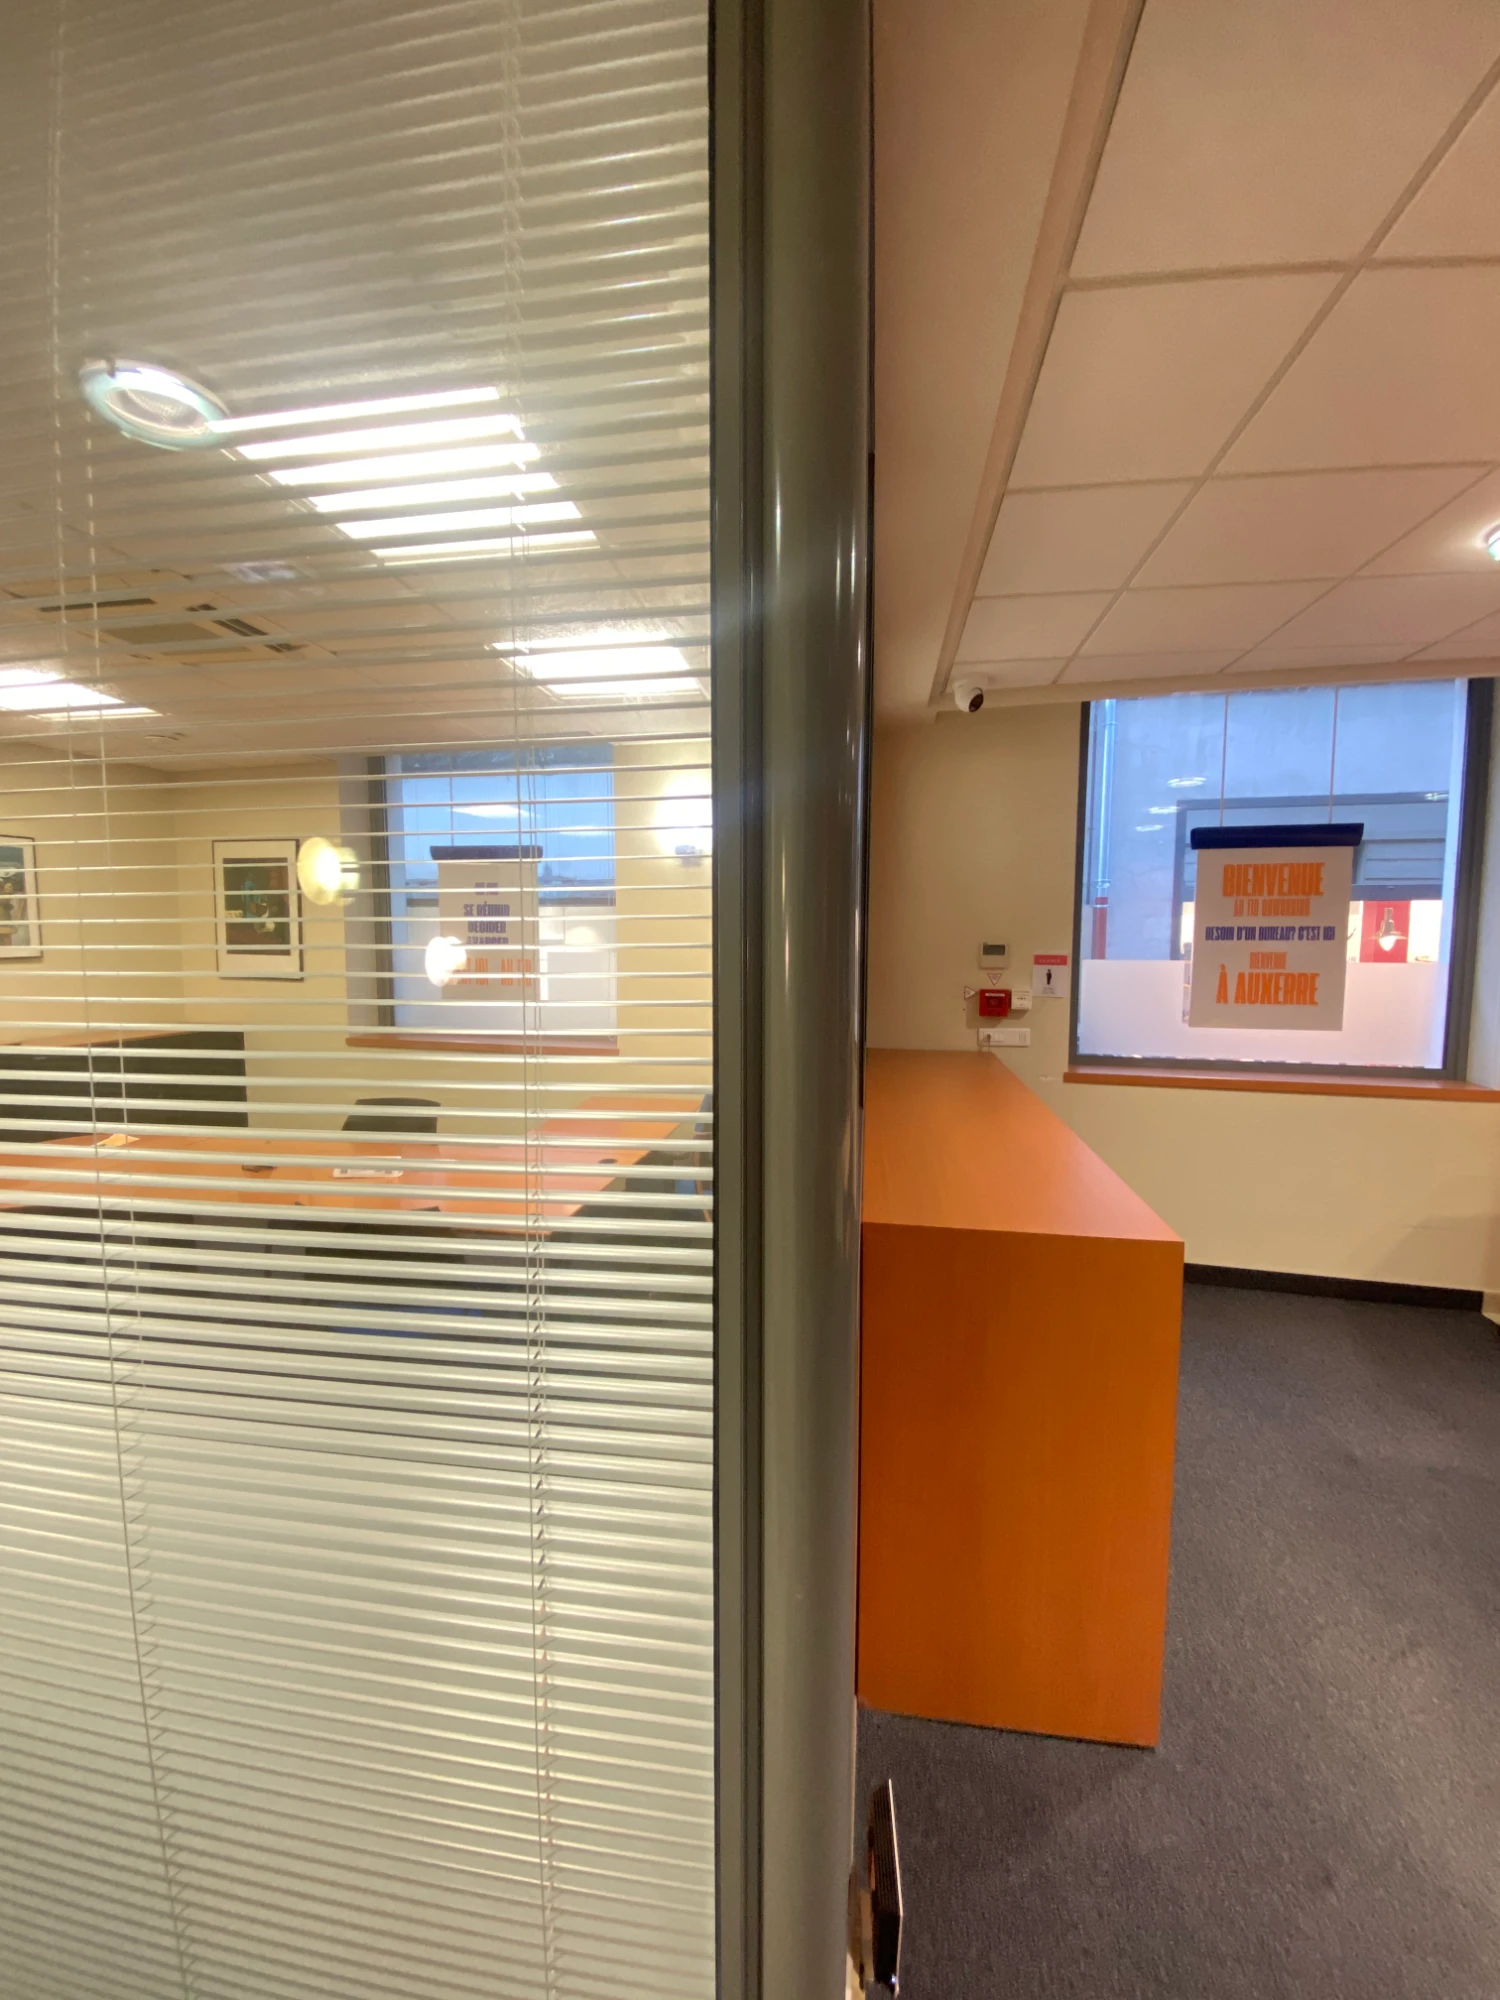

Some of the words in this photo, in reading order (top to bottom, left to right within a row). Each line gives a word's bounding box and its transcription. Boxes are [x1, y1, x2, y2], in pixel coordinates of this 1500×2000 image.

[1222, 862, 1325, 897] BIENVENUE
[463, 904, 474, 916] SE
[476, 901, 510, 916] RÉUNIR
[1205, 926, 1234, 941] BESOIN
[1236, 926, 1256, 941] D'UN
[1258, 926, 1296, 941] BUREAU?
[1298, 926, 1321, 941] C'EST
[1323, 926, 1336, 941] ICI
[1216, 963, 1229, 1004] À
[1233, 971, 1320, 1006] AUXERRE
